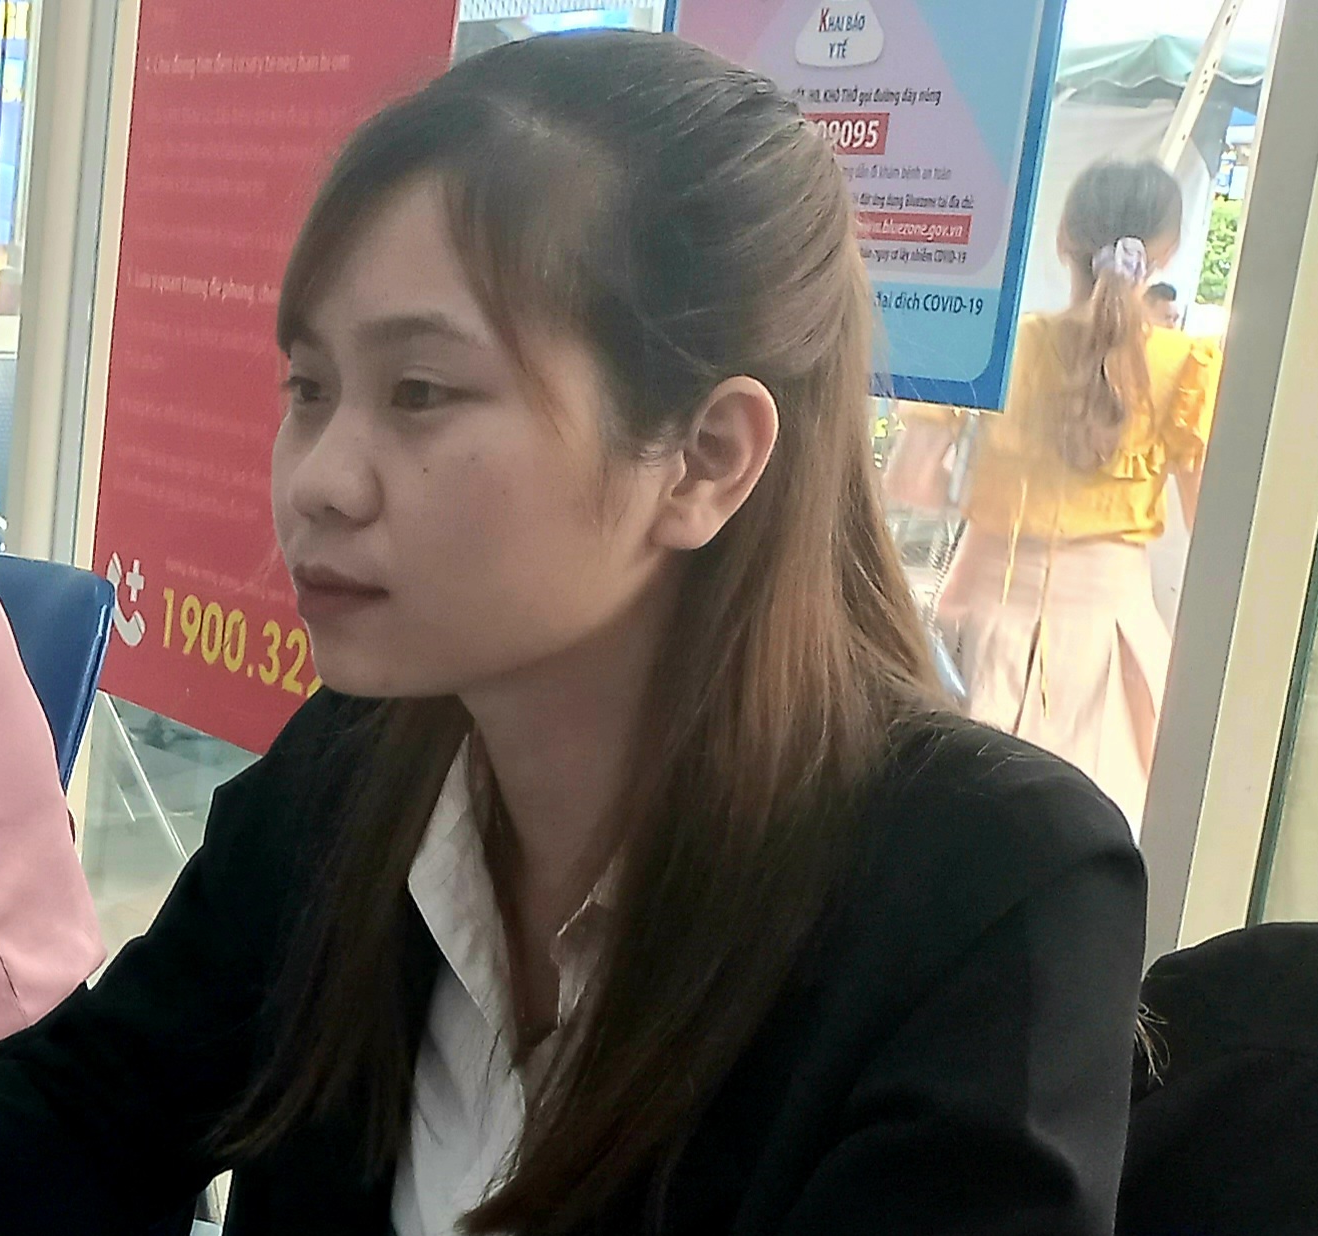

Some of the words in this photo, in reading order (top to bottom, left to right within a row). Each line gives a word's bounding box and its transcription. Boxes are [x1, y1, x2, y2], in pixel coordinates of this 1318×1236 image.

[819, 8, 845, 33] KHAI
[846, 11, 866, 32] BÁO
[923, 293, 984, 316] COVID-19
[163, 587, 323, 698] 1900.32
